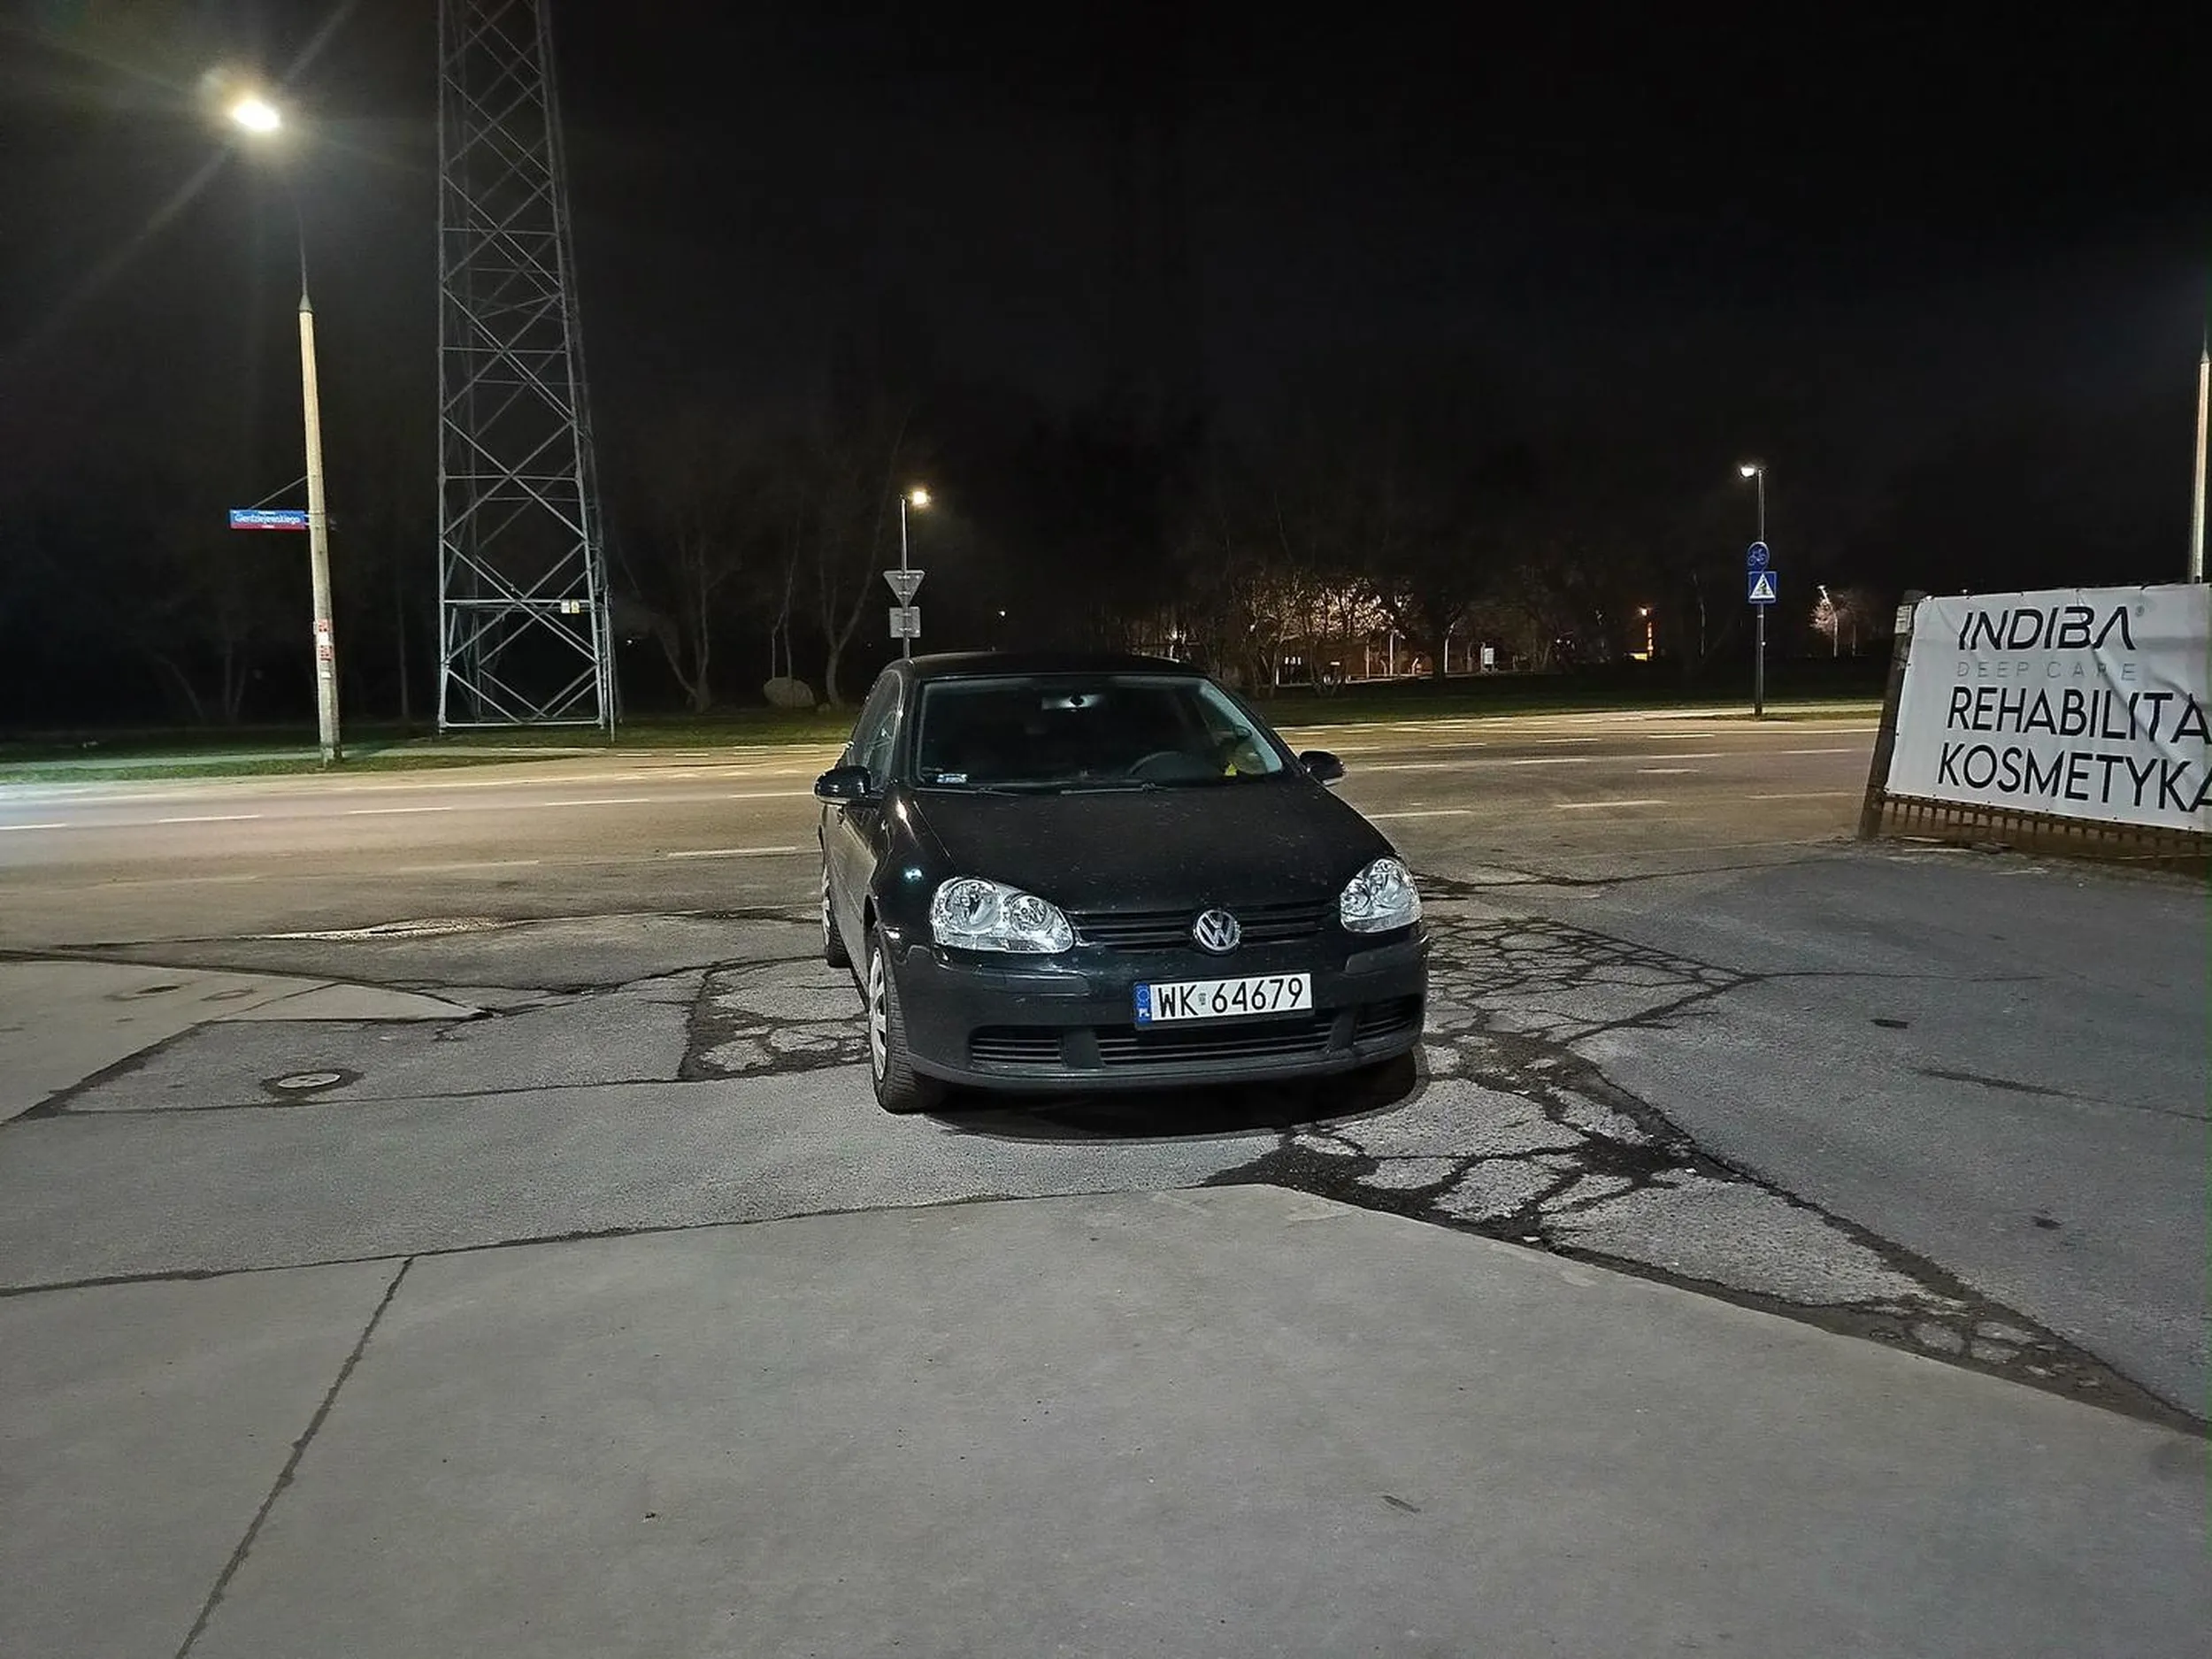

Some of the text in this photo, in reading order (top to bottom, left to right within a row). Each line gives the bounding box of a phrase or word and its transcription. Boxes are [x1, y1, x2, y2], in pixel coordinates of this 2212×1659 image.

[1958, 606, 2137, 650] INDIBA
[1956, 661, 2137, 681] DEEP CARE
[1947, 686, 2212, 745] REHABILITA
[1196, 910, 1240, 951] VW
[1157, 985, 1198, 1018] WK
[1211, 977, 1303, 1014] 64679
